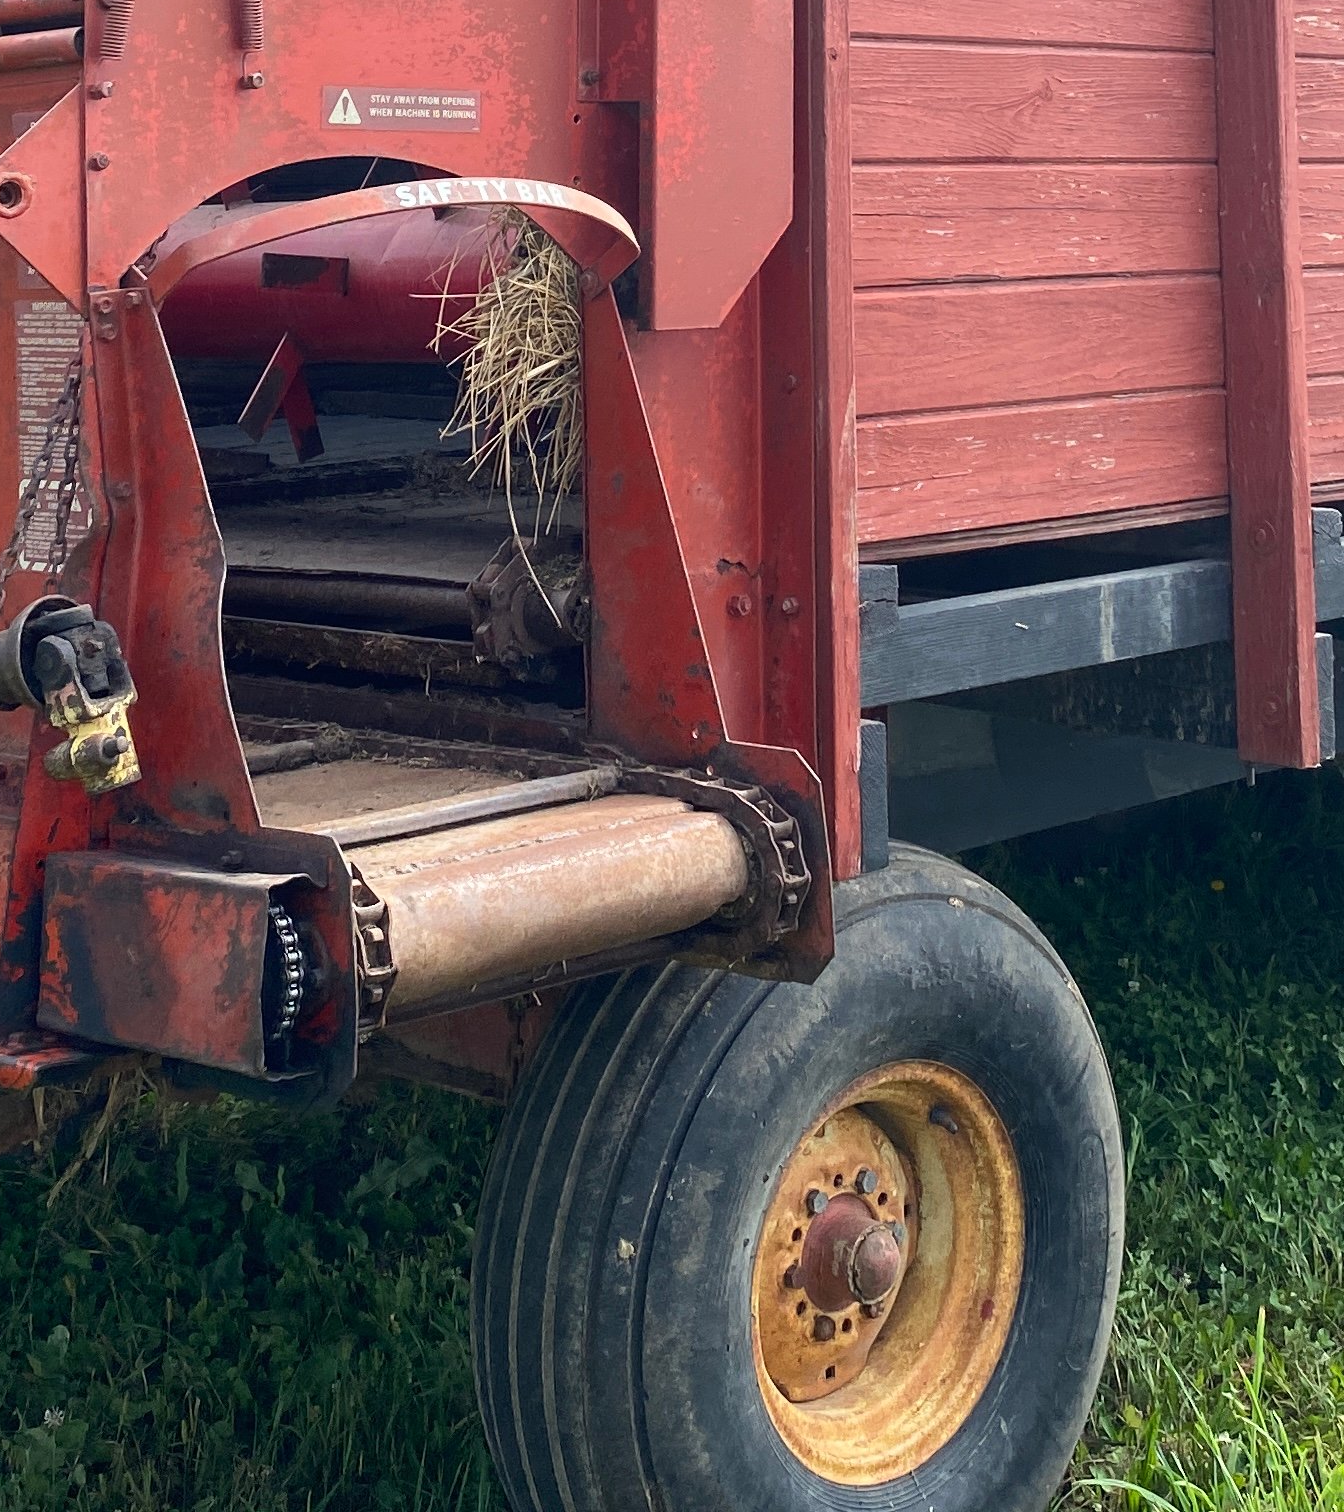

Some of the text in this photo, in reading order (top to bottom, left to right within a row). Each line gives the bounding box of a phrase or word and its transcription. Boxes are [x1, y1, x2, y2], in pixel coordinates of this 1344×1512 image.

[370, 94, 476, 107] STAY AWAY FROM OPENING
[369, 107, 477, 120] WHEN MACHINE IS RUNNING
[513, 181, 568, 207] BAR
